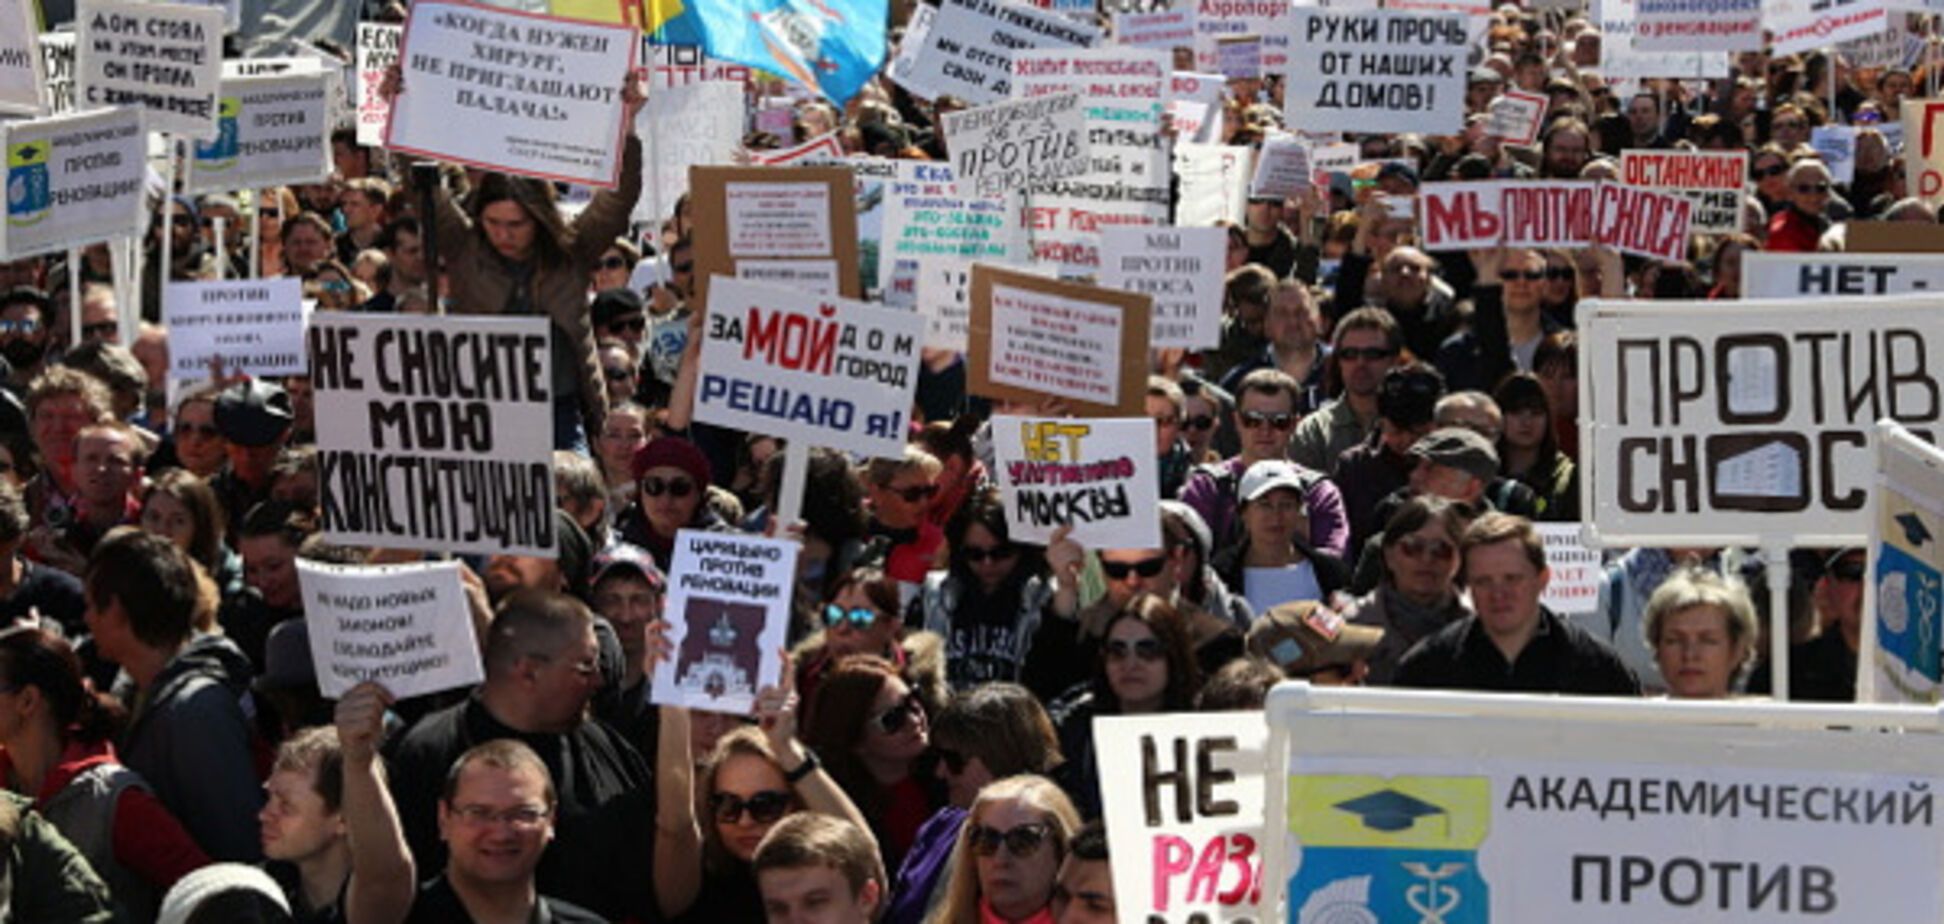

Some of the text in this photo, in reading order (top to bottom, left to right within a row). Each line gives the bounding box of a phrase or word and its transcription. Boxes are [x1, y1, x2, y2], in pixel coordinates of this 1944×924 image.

[92, 12, 205, 42] ДОМ СТОЯЛ
[527, 27, 609, 53] НУЖЕН
[1306, 17, 1468, 46] РУКИ ПРОЧЬ
[104, 61, 126, 78] ОН
[470, 43, 565, 75] ХИРУРГ,
[1320, 52, 1454, 78] ОТ НАШИХ
[411, 53, 442, 75] НЕ
[448, 58, 617, 105] ПРИГЛАШАЮТ
[1315, 81, 1435, 111] ДОМОВ!
[959, 130, 1081, 179] ПРОТИВ
[1626, 154, 1743, 188] ОСТАНКИНО
[1502, 187, 1595, 243] ПРОТИВ
[1594, 185, 1691, 261] СНОСА
[1121, 256, 1201, 272] ПРОТИВ
[1799, 265, 1897, 295] НЕТ
[709, 302, 912, 376] ЗА МОЙ ДОМ
[311, 326, 549, 401] НЕ СНОСИТЕ
[835, 353, 907, 389] ГОРОД
[1617, 329, 1940, 425] ПРОТИВ
[700, 374, 855, 432] РЕШАЮ
[368, 401, 493, 452] МОЮ
[1021, 421, 1090, 463] НЕТ
[1617, 430, 1867, 514] СНОС
[317, 450, 553, 549] КОНСТИТУЦИЮ
[1017, 484, 1131, 526] МОСКВЫ
[689, 538, 782, 561] ЦАРИЦЫНО
[700, 557, 764, 578] ПРОТИВ
[375, 587, 437, 608] НОВЫХ
[680, 574, 780, 597] РЕНОВАЦИИ
[1140, 733, 1240, 828] НЕ
[1506, 775, 1934, 826] АКАДЕМИЧЕСКИЙ
[1571, 853, 1837, 915] ПРОТИВ
